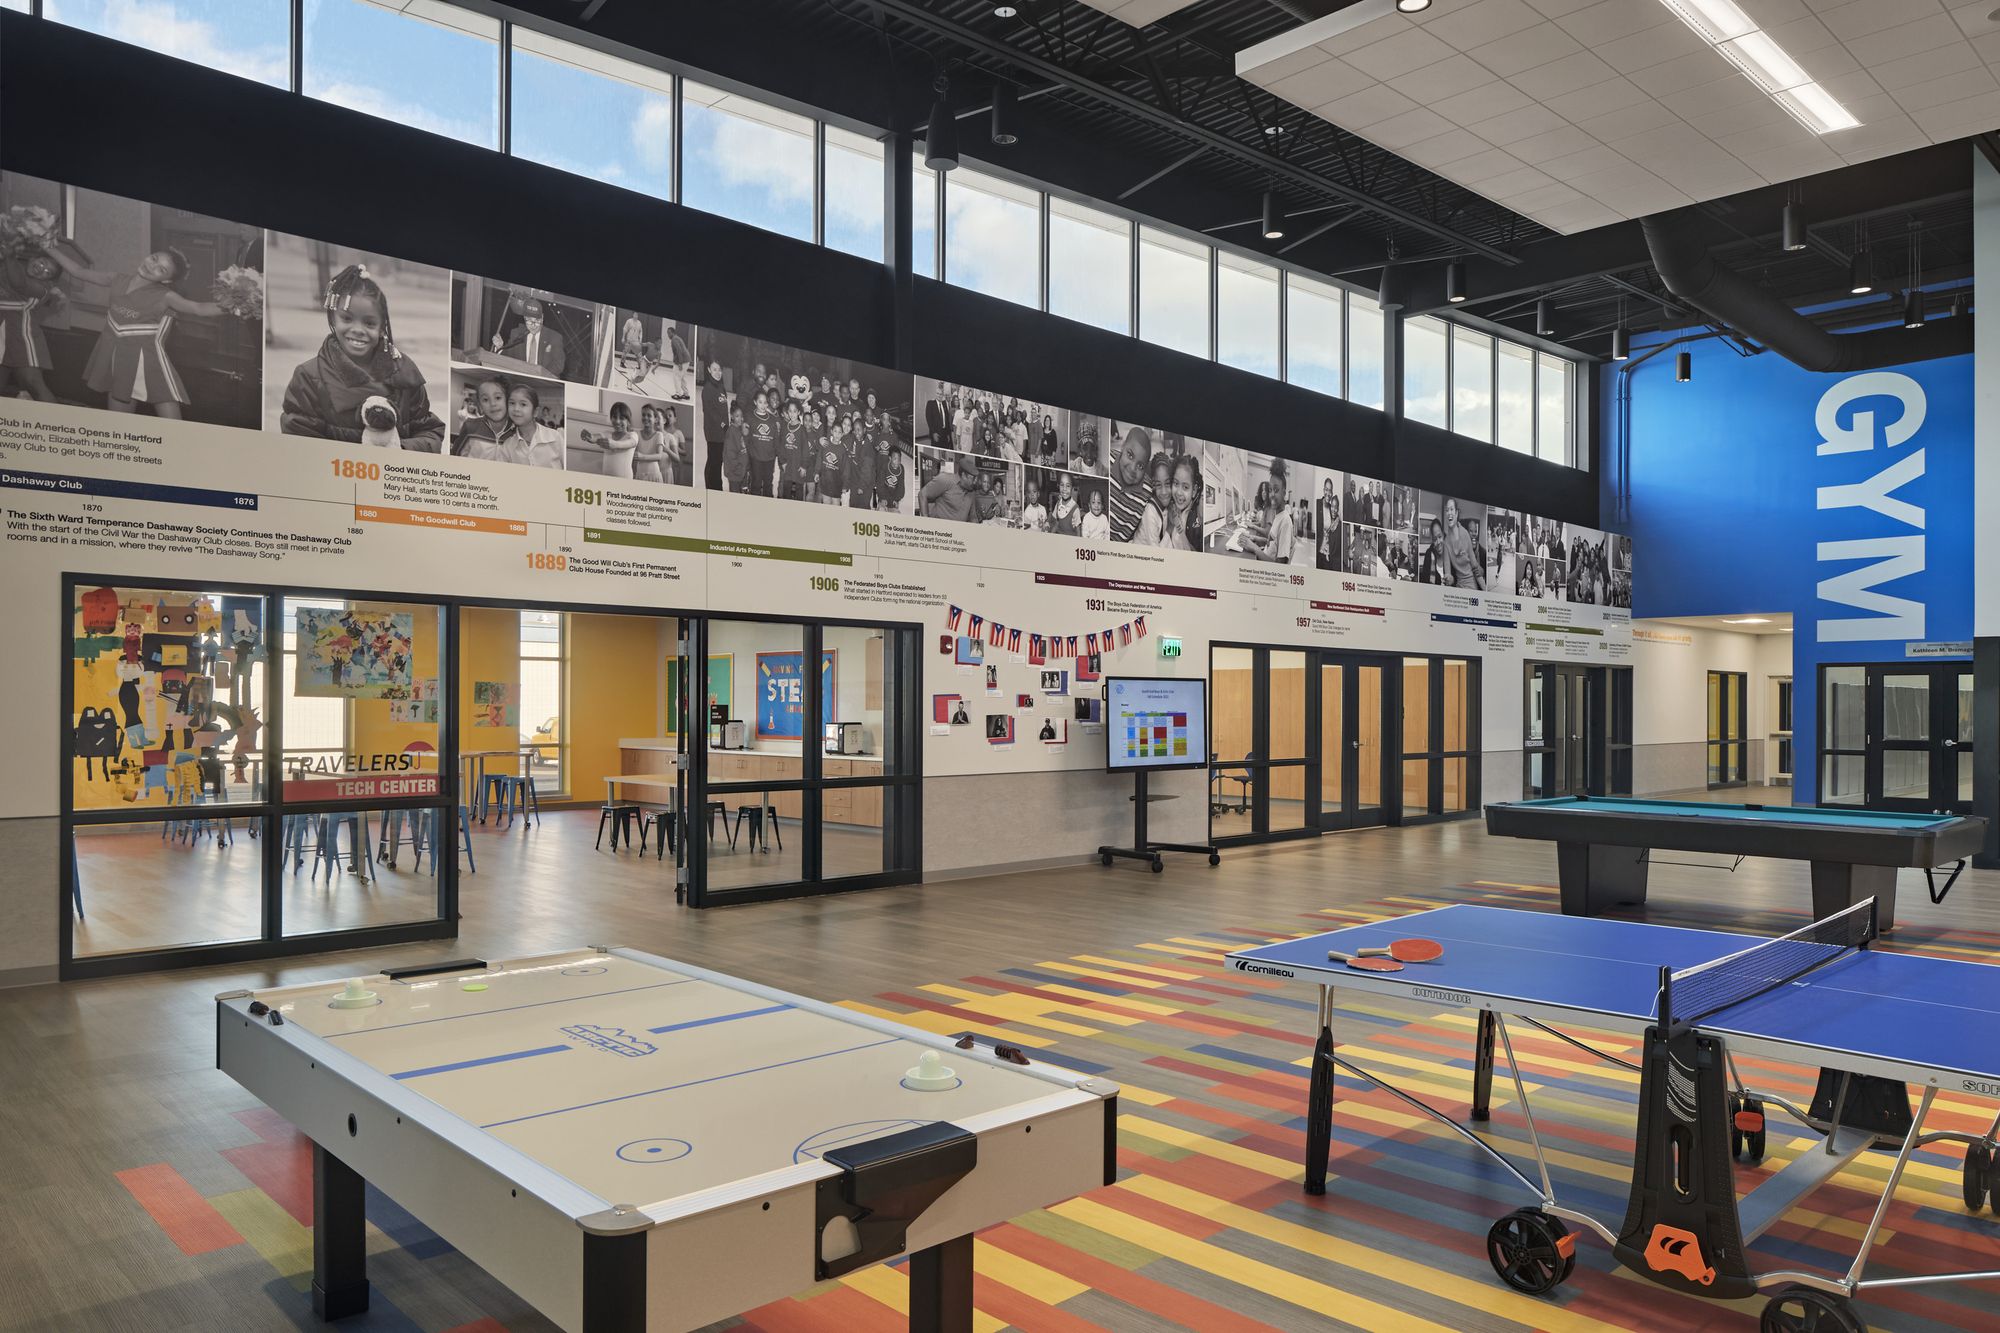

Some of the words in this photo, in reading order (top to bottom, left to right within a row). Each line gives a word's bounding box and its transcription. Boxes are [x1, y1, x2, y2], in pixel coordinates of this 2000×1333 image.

[22, 420, 32, 429] in
[34, 422, 76, 434] America
[78, 427, 110, 438] Opens
[124, 433, 162, 444] Hartford
[0, 429, 46, 442] Goodwin,
[48, 434, 90, 446] Elizabeth
[92, 440, 141, 453] Hamersley,
[23, 443, 47, 452] Club
[60, 448, 76, 456] get
[78, 449, 101, 459] boys
[116, 453, 131, 461] the
[133, 456, 162, 465] streets
[331, 459, 380, 480] 1880
[384, 465, 405, 475] Good
[421, 469, 438, 477] Club
[439, 471, 471, 481] Founded
[2, 474, 56, 488] Dashaway
[58, 480, 83, 489] Club
[383, 474, 430, 485] Connecticut's
[445, 481, 467, 489] female
[468, 484, 489, 492] lawyer,
[383, 484, 402, 492] Mary
[402, 485, 418, 493] Hall,
[439, 489, 459, 497] Good
[472, 493, 488, 501] Club
[565, 488, 602, 506] 1891
[82, 504, 103, 512] 1870
[234, 497, 255, 506] 1876
[606, 500, 644, 511] Woodworking
[621, 494, 648, 502] Industrial
[648, 496, 676, 505] Programs
[677, 500, 702, 508] Founded
[1815, 372, 1926, 642] GYM
[425, 516, 458, 525] Goodwill
[648, 514, 673, 522] plumbing
[6, 510, 27, 519] The
[29, 512, 55, 521] Sixth
[57, 514, 84, 524] Ward
[85, 516, 145, 528] Temperance
[146, 522, 194, 534] Dashaway
[195, 526, 229, 536] Society
[230, 529, 273, 539] Continues
[290, 534, 332, 545] Dashaway
[333, 537, 352, 545] Club
[852, 522, 880, 537] 1909
[884, 525, 893, 533] The
[6, 521, 30, 530] With
[31, 523, 48, 532] the
[49, 525, 71, 533] start
[84, 527, 99, 536] the
[101, 528, 120, 537] Civil
[121, 530, 140, 538] War
[157, 533, 202, 544] Dashaway
[203, 536, 223, 545] Club
[224, 539, 252, 547] closes.
[254, 540, 274, 550] Boys
[6, 533, 38, 542] rooms
[79, 538, 116, 548] mission,
[118, 541, 146, 549] where
[148, 543, 167, 552] they
[195, 546, 214, 554] "The
[216, 548, 258, 558] Dashaway
[259, 551, 286, 560] Song."
[526, 553, 566, 571] 1889
[1075, 548, 1096, 561] 1930
[810, 576, 839, 591] 1906
[1290, 575, 1304, 586] 1956
[1342, 581, 1356, 592] 1964
[1086, 599, 1105, 611] 1931
[1296, 617, 1311, 628] 1957
[1477, 633, 1488, 642] 1992
[768, 678, 803, 702] STE
[284, 754, 410, 774] TRAVELERS
[336, 780, 375, 796] TECH
[380, 779, 437, 796] CENTER
[1247, 964, 1294, 978] cornilleau
[1412, 988, 1472, 1004] OUTDOOR
